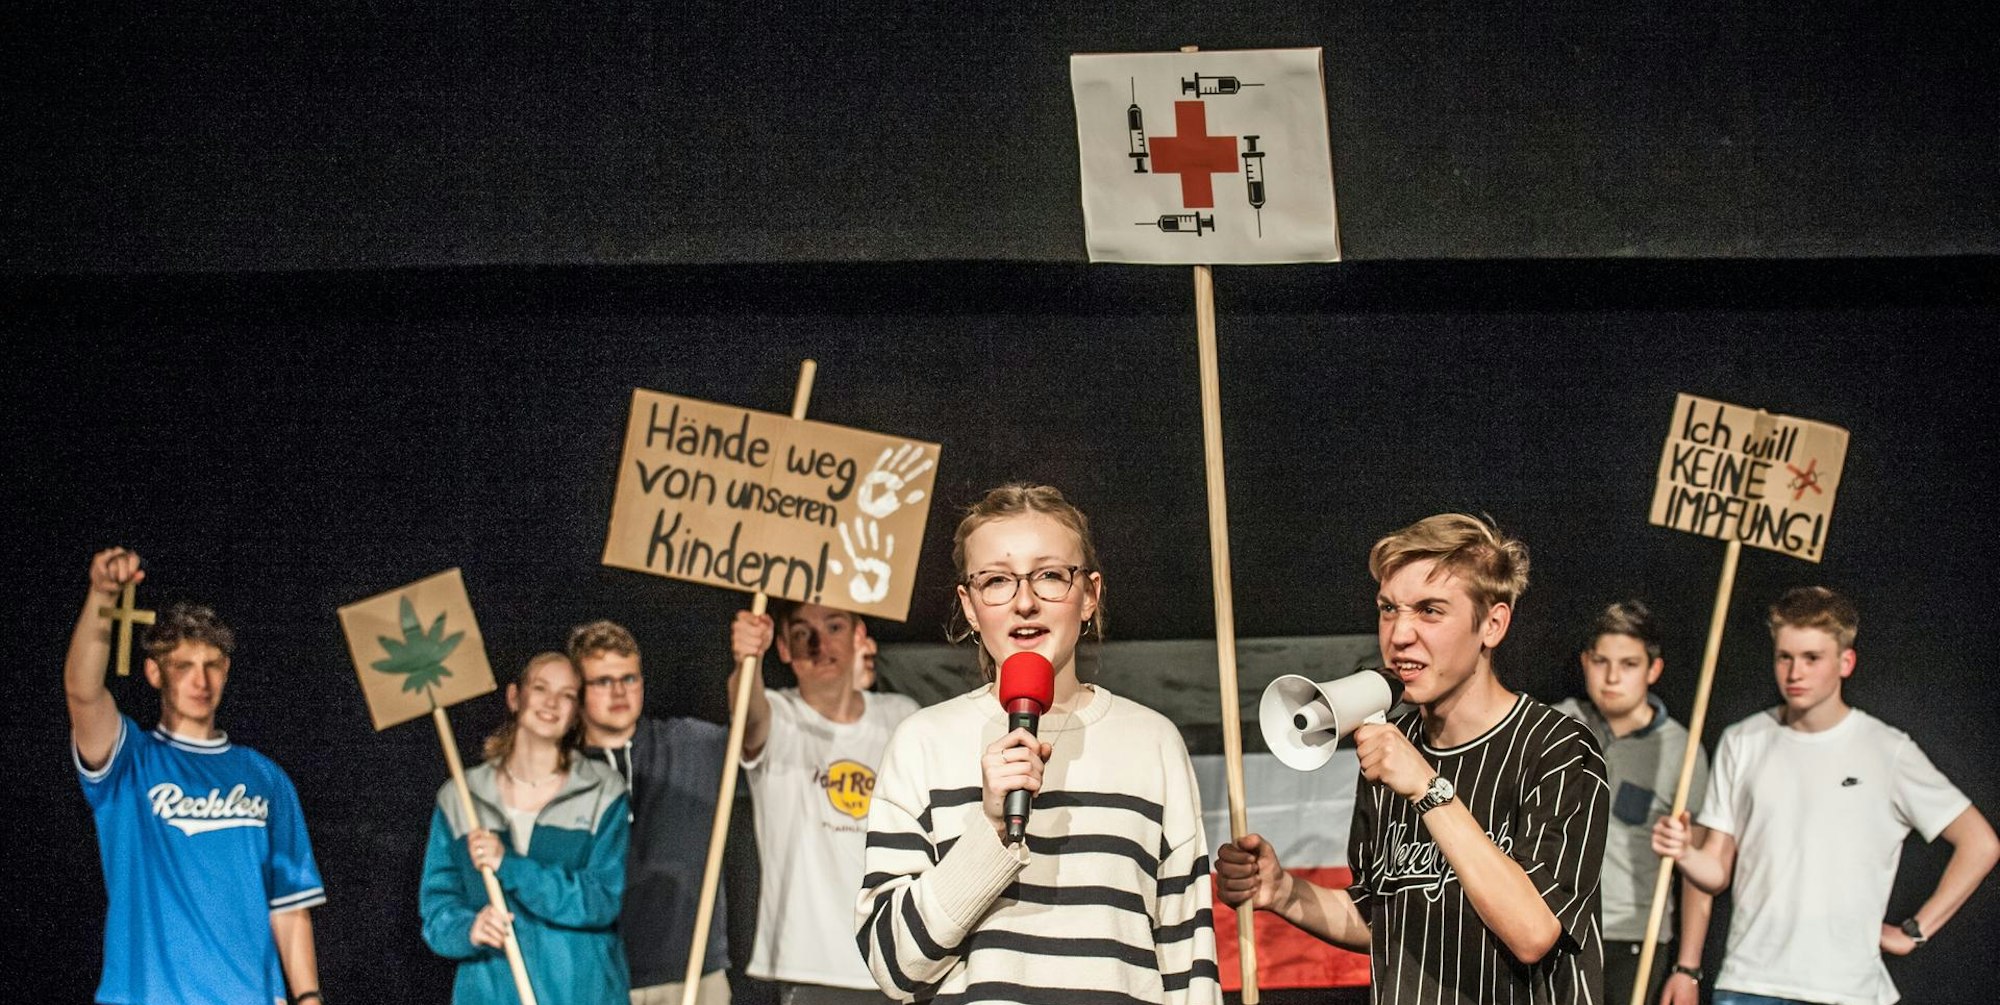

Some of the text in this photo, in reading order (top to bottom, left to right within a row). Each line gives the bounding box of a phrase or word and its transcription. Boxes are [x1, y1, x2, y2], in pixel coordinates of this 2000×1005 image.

[646, 402, 857, 501] Hände weg
[1682, 400, 1799, 463] Ich will
[636, 459, 838, 528] von unseren
[1670, 443, 1773, 500] KEINE
[1664, 485, 1823, 557] IMPFUNG!
[646, 508, 831, 604] Kindern!
[147, 782, 269, 820] Reckless
